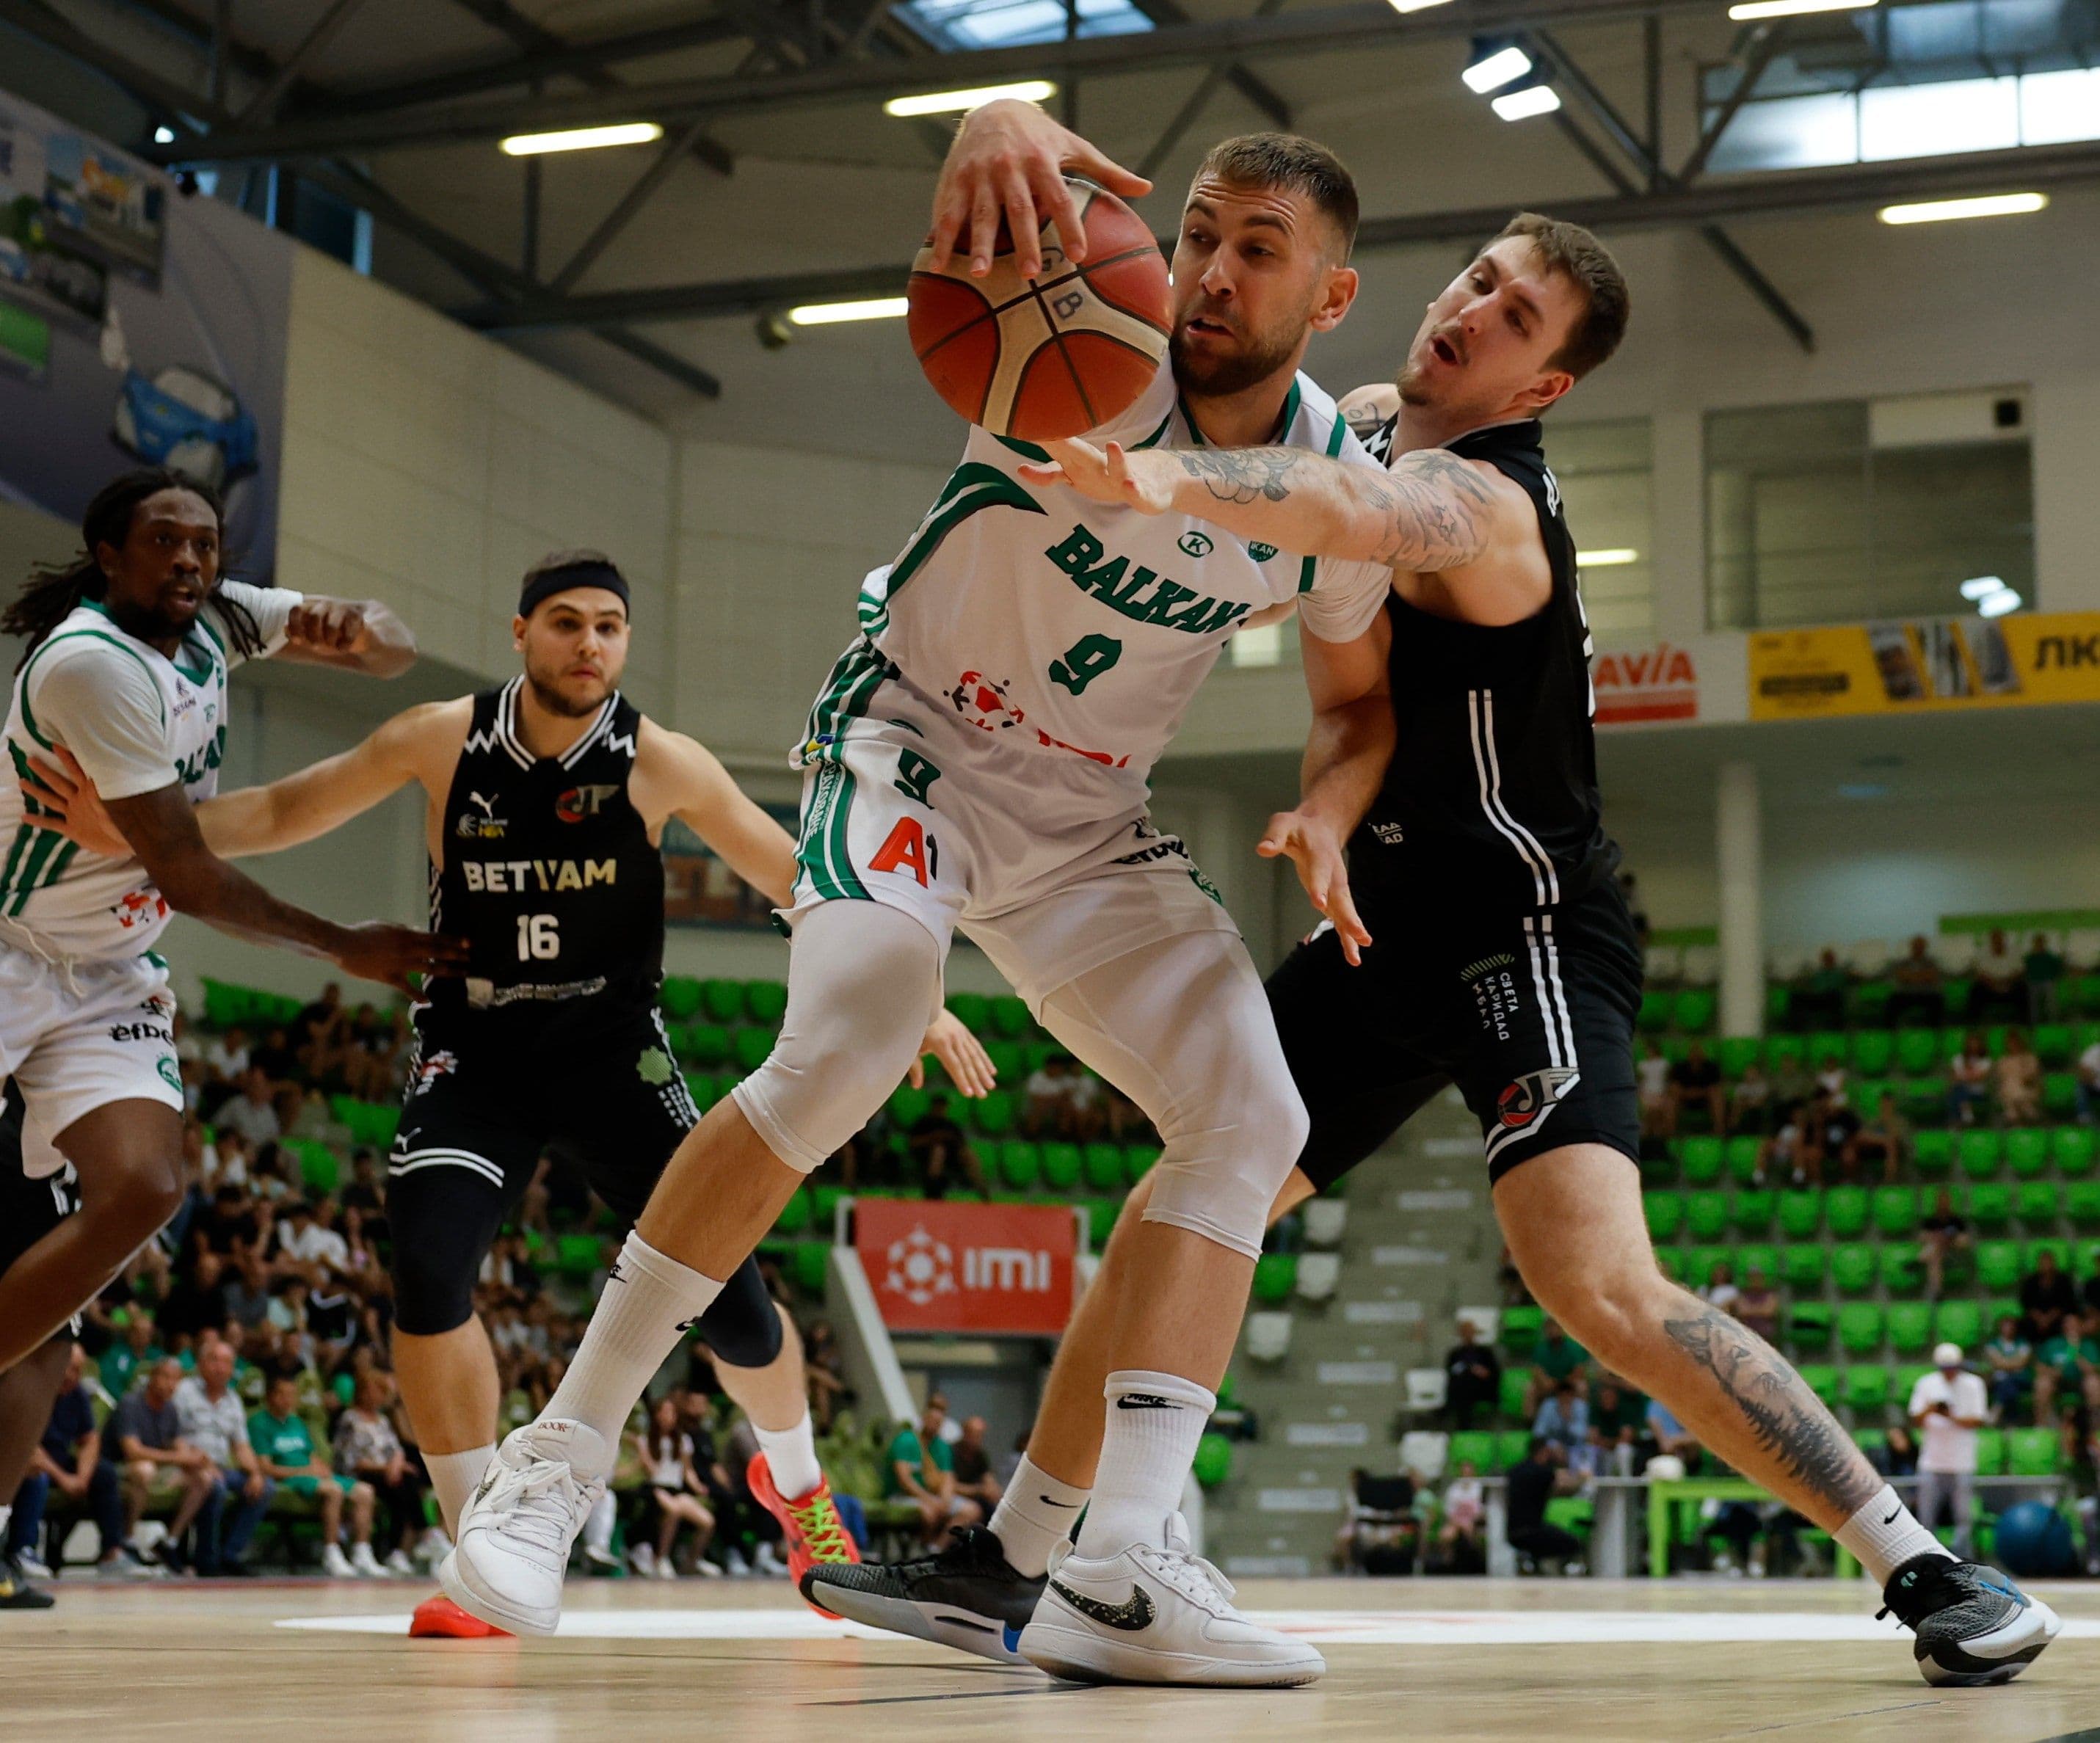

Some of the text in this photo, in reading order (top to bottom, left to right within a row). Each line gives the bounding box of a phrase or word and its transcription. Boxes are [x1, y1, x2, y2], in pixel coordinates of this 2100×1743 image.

[1187, 537, 1205, 553] K
[1044, 523, 1252, 634] BALKAN
[1049, 633, 1122, 696] 9
[1594, 641, 1698, 688] AVIA
[868, 816, 938, 889] A1
[517, 914, 560, 962] 16
[1485, 976, 1511, 1041] КАРИДАД
[1500, 972, 1519, 1012] СВЕТА
